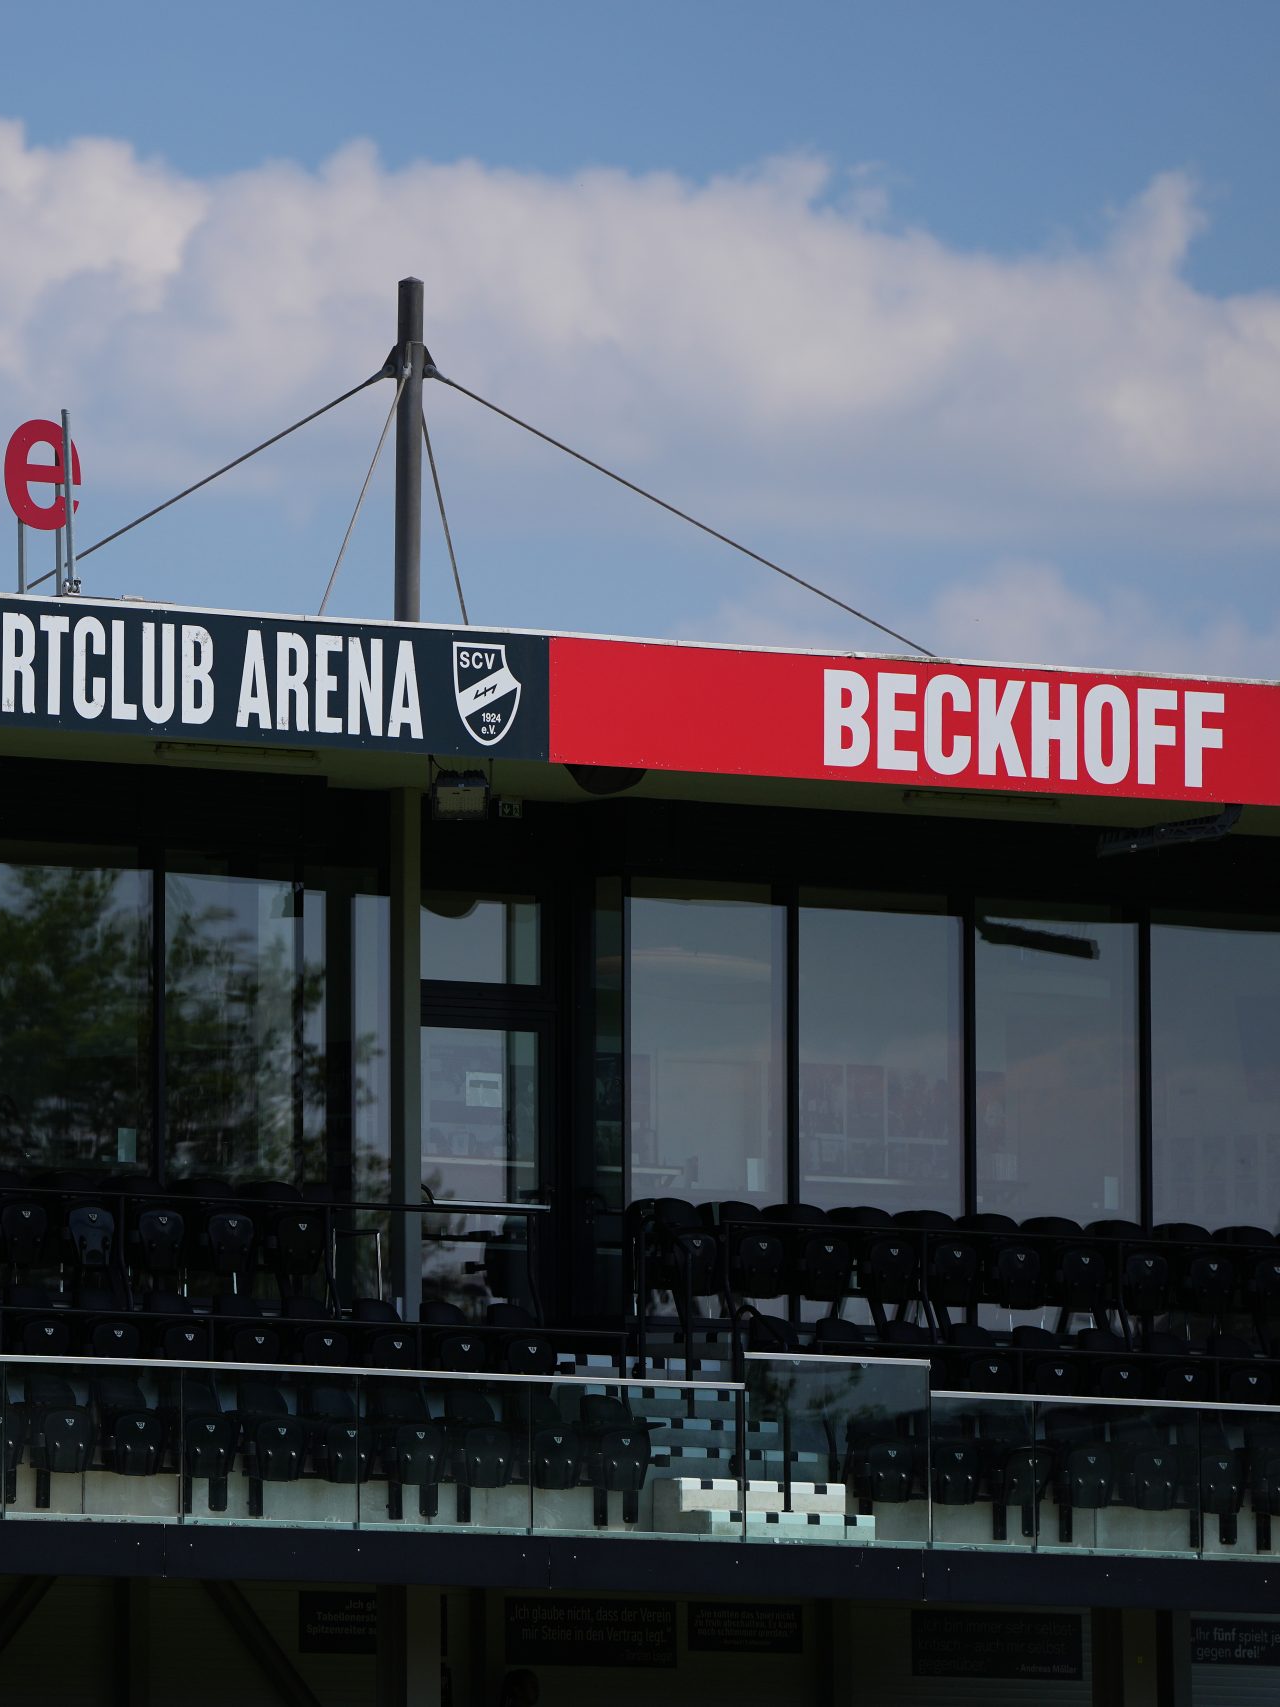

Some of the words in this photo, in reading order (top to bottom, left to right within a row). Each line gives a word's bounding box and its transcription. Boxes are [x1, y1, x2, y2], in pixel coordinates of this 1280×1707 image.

[459, 650, 495, 670] SCV
[236, 629, 424, 740] ARENA
[481, 712, 501, 723] 1924
[481, 724, 496, 735] e.V.
[823, 668, 1225, 788] BECKHOFF
[531, 1605, 565, 1623] glaube
[567, 1606, 594, 1623] nicht,
[595, 1606, 619, 1621] dass
[620, 1607, 638, 1622] der
[639, 1607, 672, 1623] Verein
[306, 1624, 366, 1636] Spitzenreiter
[944, 1616, 963, 1633] bin
[966, 1618, 1002, 1634] immer
[1005, 1619, 1031, 1634] sehr
[521, 1627, 539, 1641] mir
[541, 1625, 572, 1641] Steine
[574, 1627, 584, 1641] in
[585, 1627, 604, 1641] den
[606, 1627, 643, 1646] Vertrag
[1213, 1626, 1236, 1642] fünf
[1238, 1628, 1268, 1646] spielt
[1006, 1639, 1025, 1653] mir
[1196, 1647, 1231, 1661] gegen
[1020, 1663, 1051, 1673] Andreas
[1052, 1663, 1077, 1674] Möller
